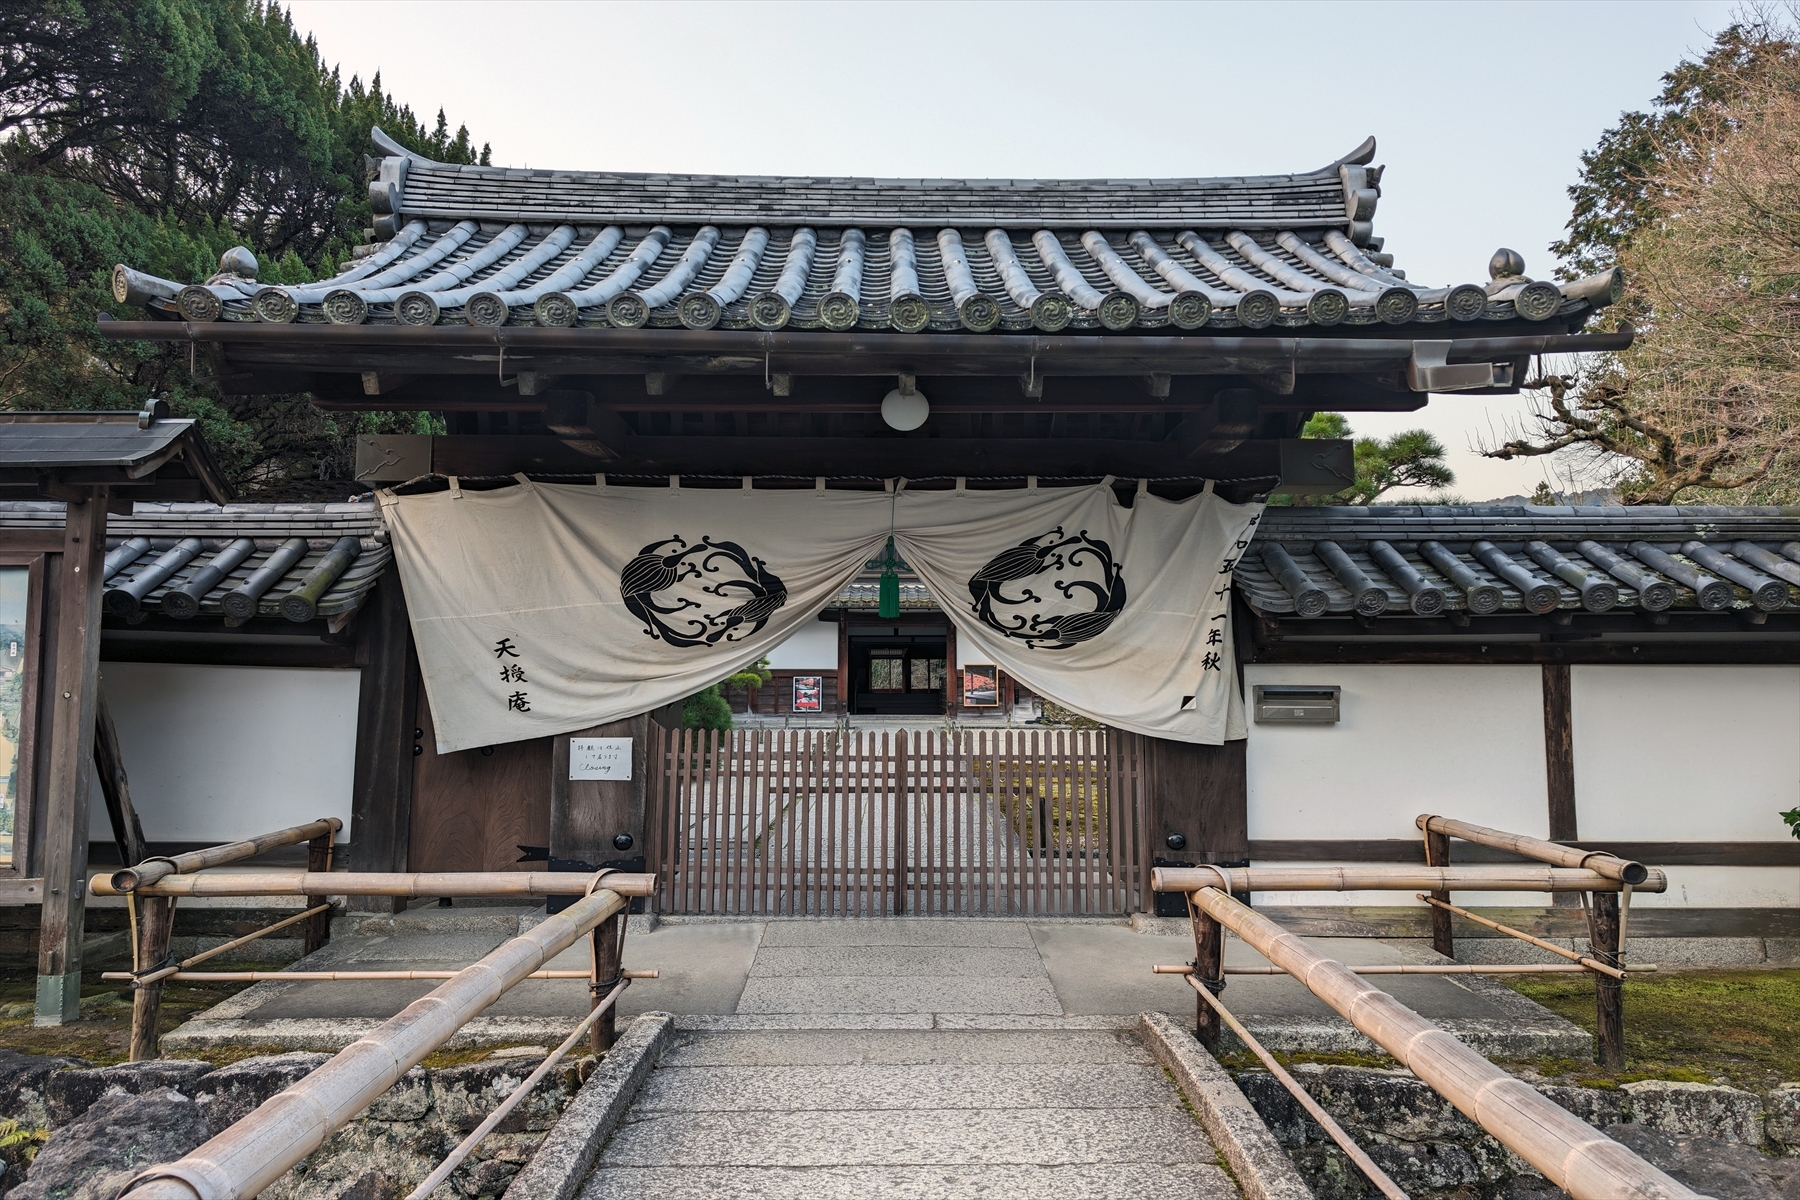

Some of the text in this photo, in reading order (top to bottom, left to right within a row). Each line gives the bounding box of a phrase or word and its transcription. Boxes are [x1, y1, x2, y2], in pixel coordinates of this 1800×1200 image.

[493, 637, 531, 712] 天授庵
[578, 763, 612, 774] Closing
